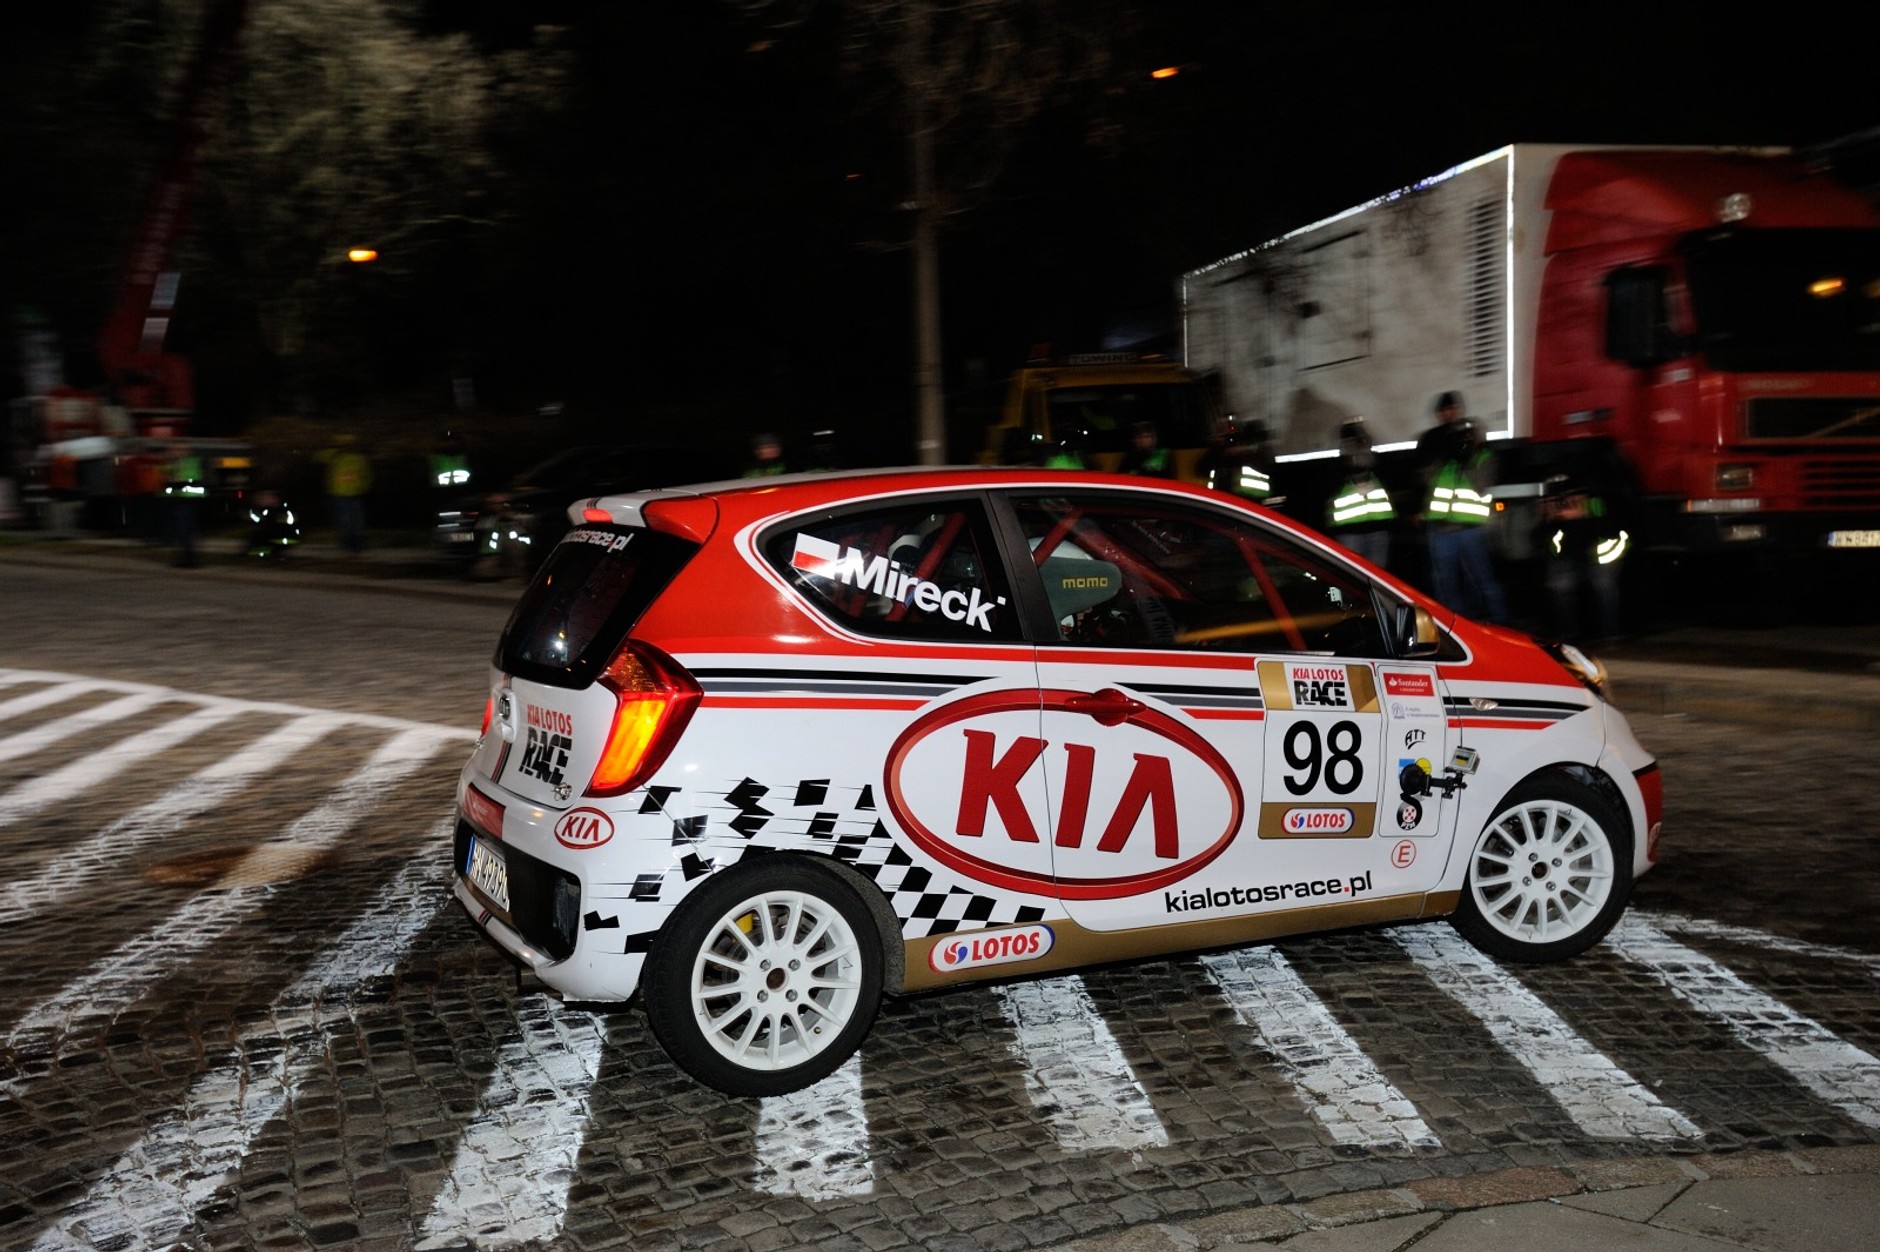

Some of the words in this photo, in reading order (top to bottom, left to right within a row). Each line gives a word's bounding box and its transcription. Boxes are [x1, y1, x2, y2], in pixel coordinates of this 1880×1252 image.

[1292, 667, 1312, 681] KIA
[1313, 668, 1345, 682] LOTOS
[1293, 680, 1348, 707] RACE
[527, 703, 540, 728] KIA
[540, 708, 573, 737] LOTOS
[518, 726, 573, 786] RACE
[1283, 720, 1364, 796] 98
[956, 728, 1180, 860] KIA
[561, 816, 599, 842] KIA
[1306, 812, 1346, 829] LOTOS
[1397, 845, 1411, 863] E
[1164, 870, 1373, 913] kialotosrace.pl
[971, 932, 1040, 961] LOTOS
